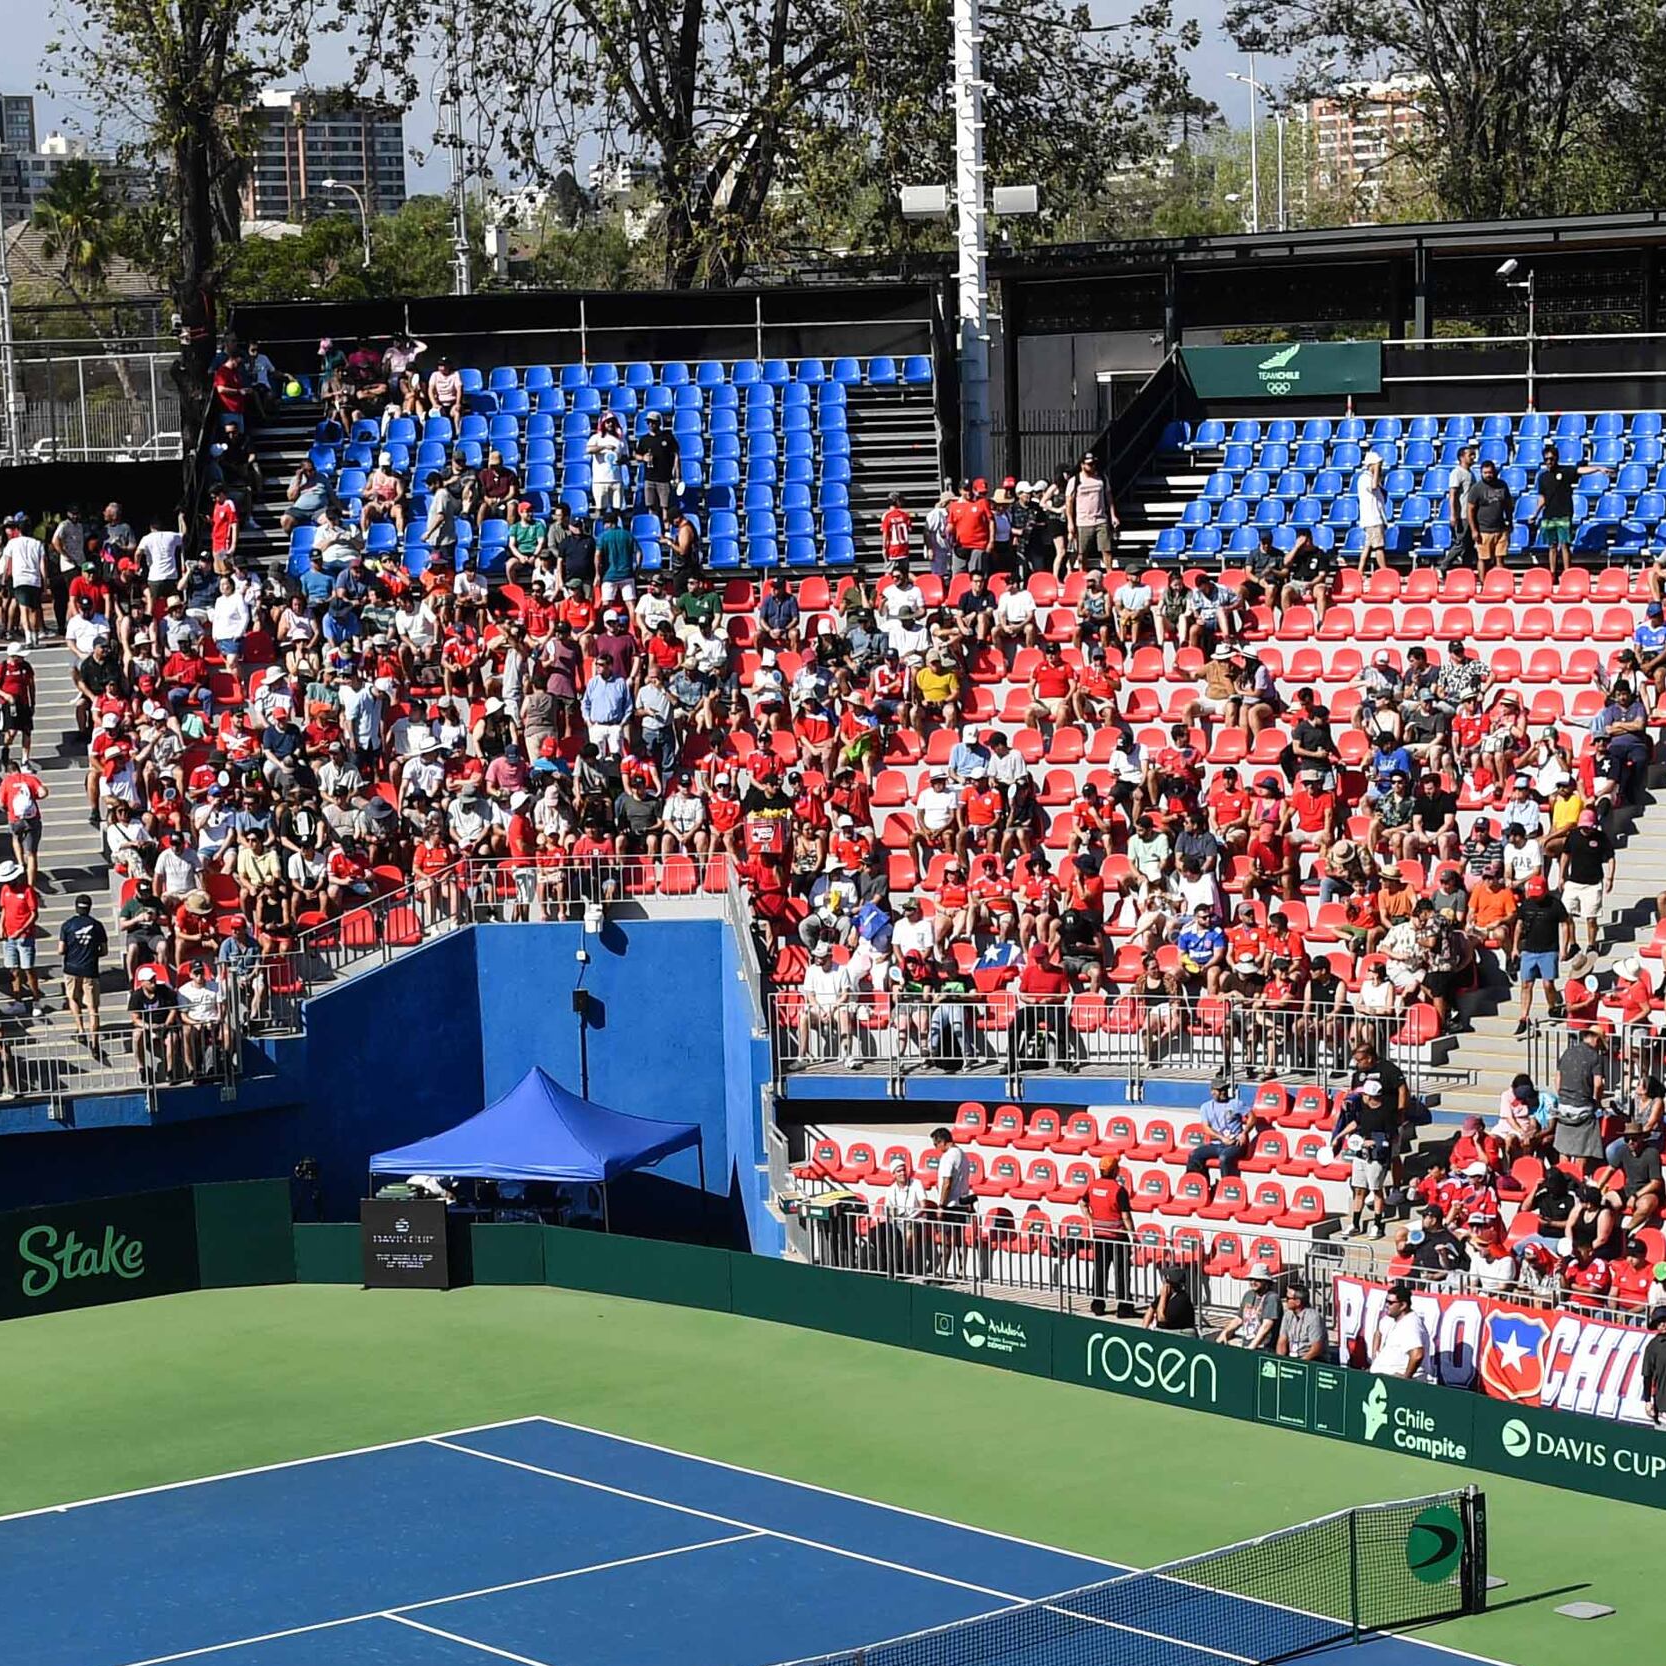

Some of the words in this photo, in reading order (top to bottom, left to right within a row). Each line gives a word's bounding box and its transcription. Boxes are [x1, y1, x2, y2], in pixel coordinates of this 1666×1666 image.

[891, 524, 908, 544] 10
[18, 1224, 145, 1297] Stake
[1087, 1332, 1217, 1402] rosen
[1394, 1407, 1435, 1431] Chile
[1393, 1428, 1467, 1460] Compite
[1536, 1431, 1606, 1467] DAVIS
[1613, 1449, 1666, 1478] CUP
